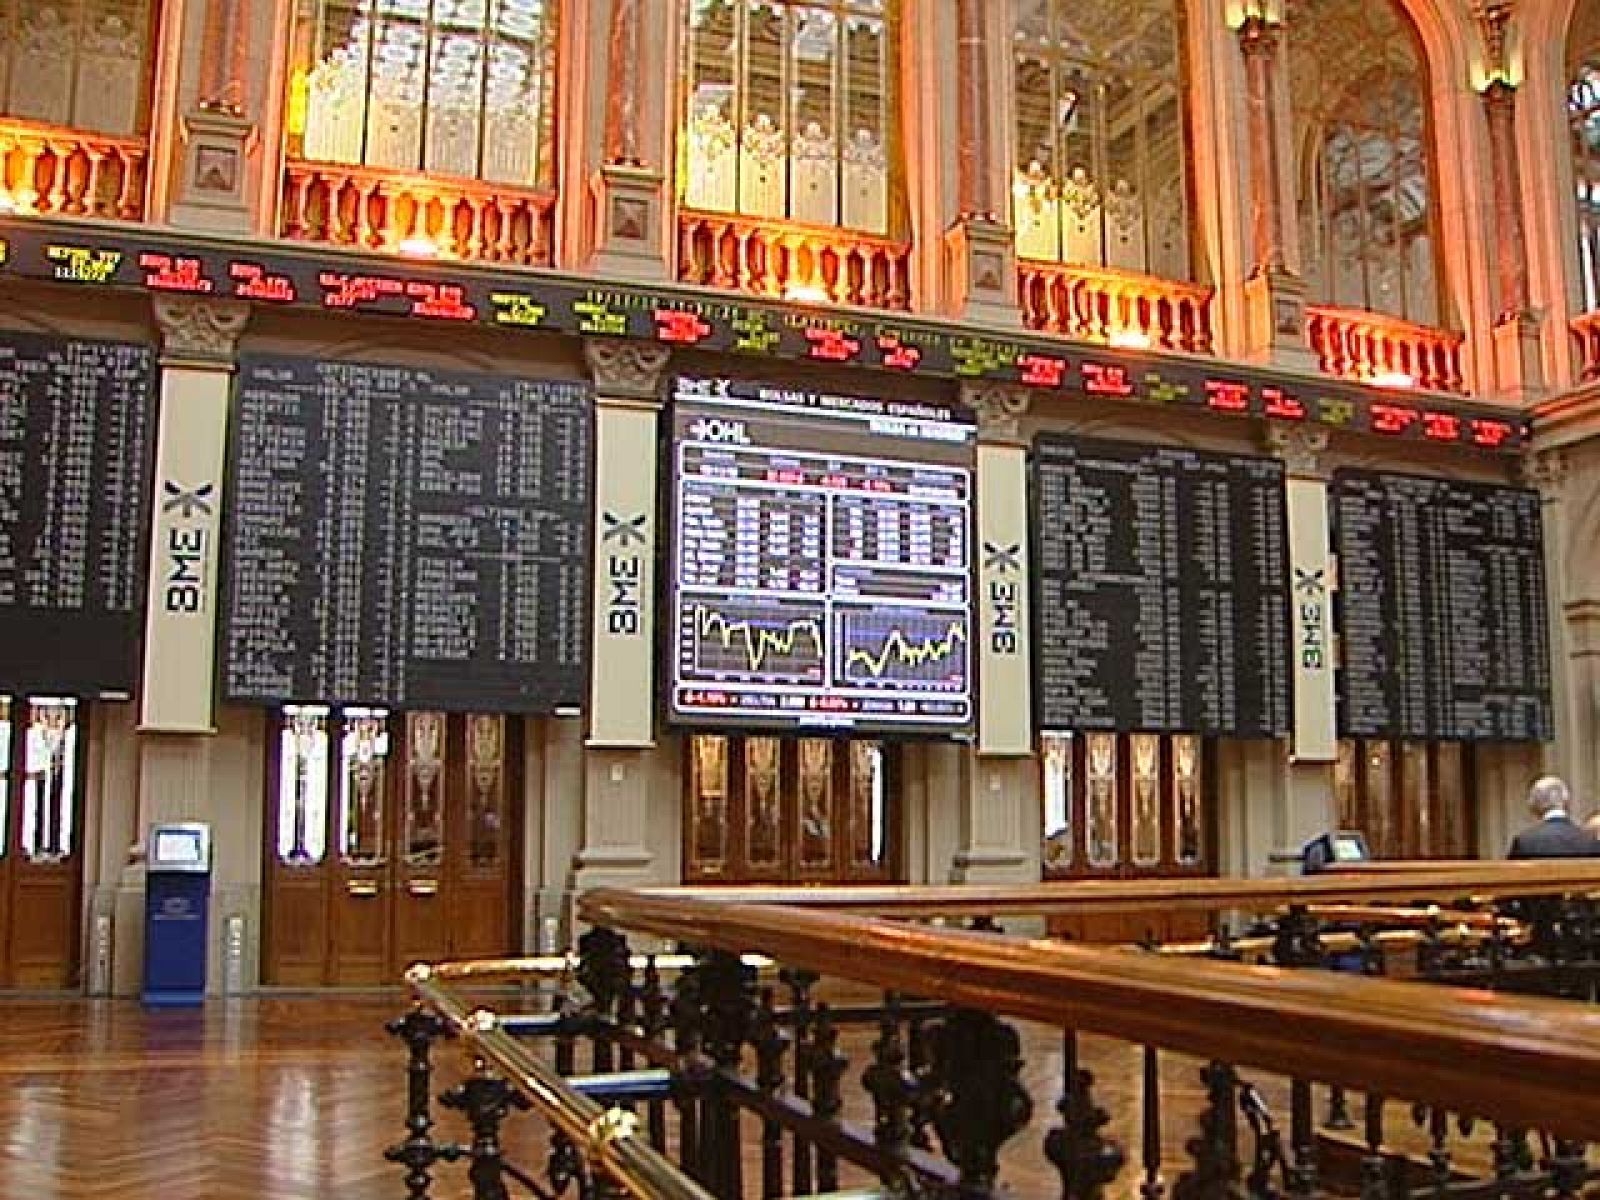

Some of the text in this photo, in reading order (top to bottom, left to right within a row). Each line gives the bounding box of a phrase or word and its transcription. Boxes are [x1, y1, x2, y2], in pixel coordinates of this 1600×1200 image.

[706, 418, 750, 443] OHL
[166, 527, 201, 612] BME
[609, 555, 638, 633] BME
[990, 581, 1016, 653] BME
[1300, 604, 1321, 668] BME
